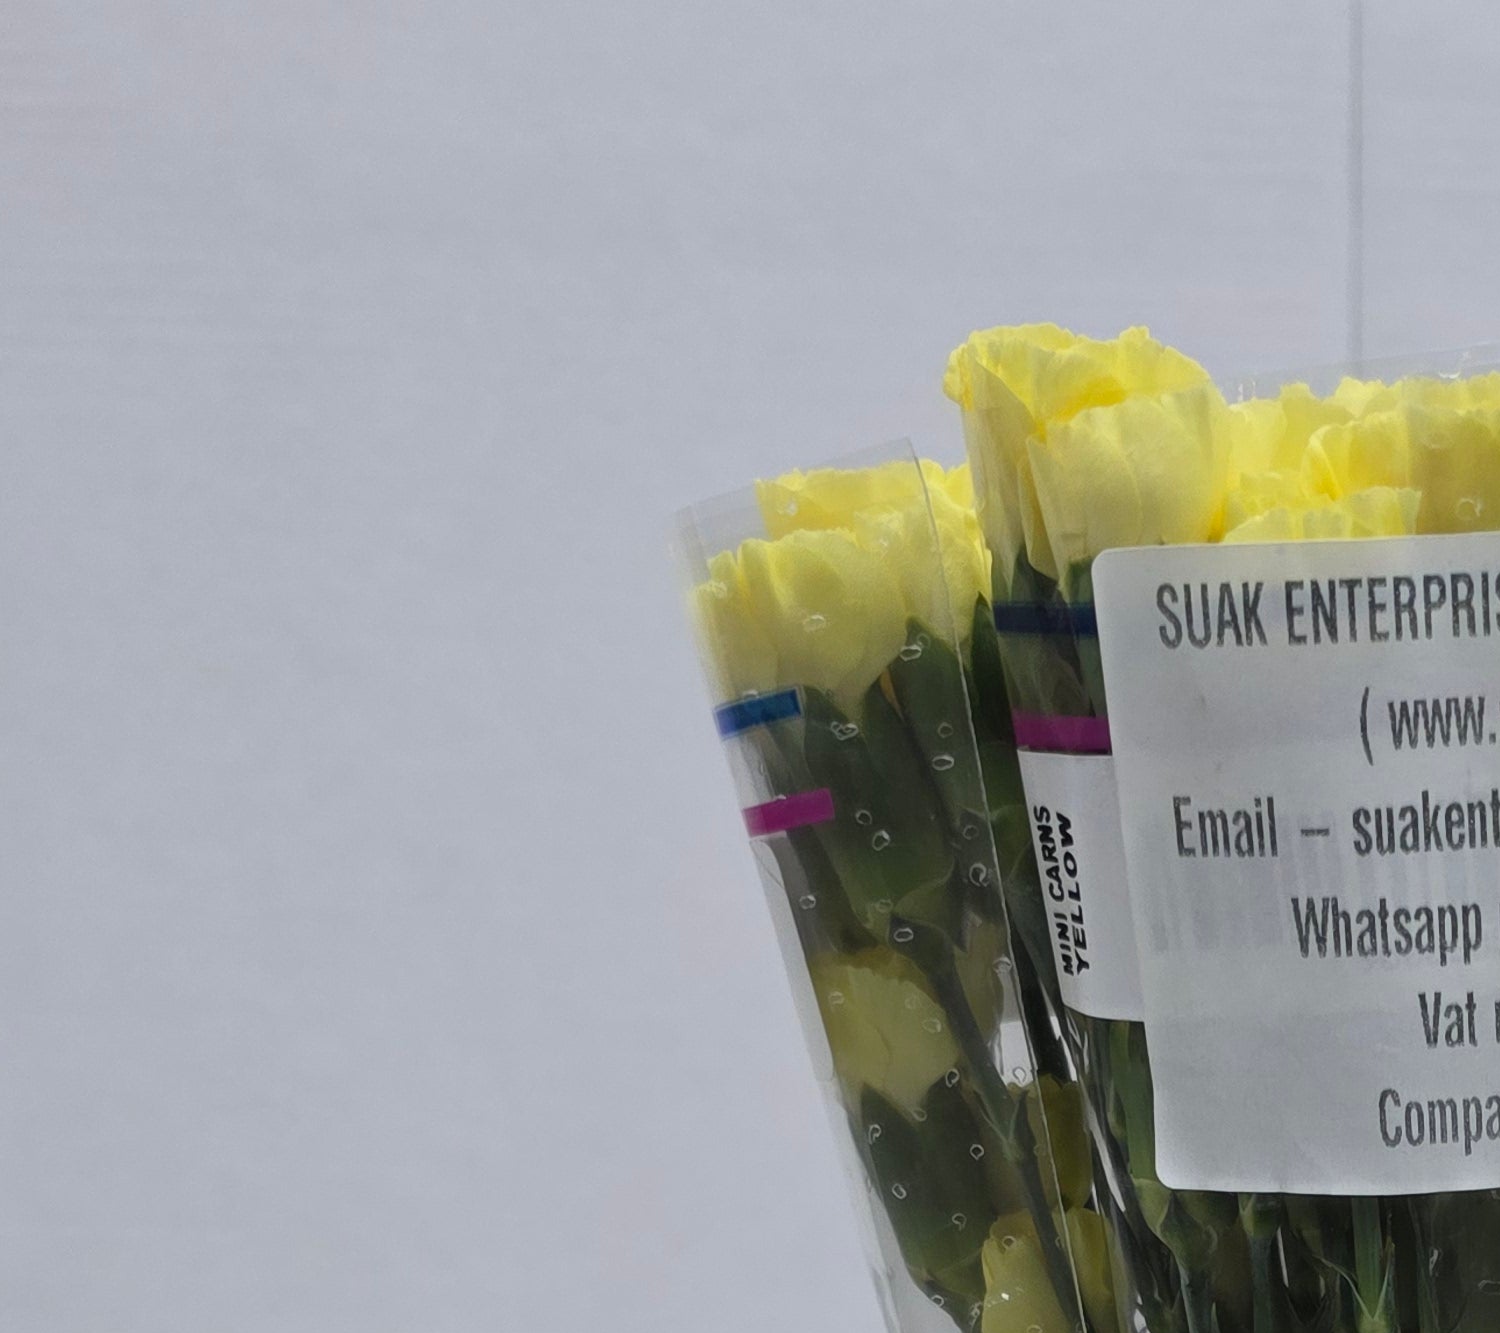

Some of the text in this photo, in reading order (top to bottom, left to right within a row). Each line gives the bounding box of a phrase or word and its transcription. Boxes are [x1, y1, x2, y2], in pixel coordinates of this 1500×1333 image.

[1157, 582, 1267, 649] SUAK
[1172, 795, 1277, 858] Email
[1033, 805, 1075, 977] MINI CARNS
[1056, 812, 1090, 975] YELLOW
[1290, 896, 1482, 967] Whatsapp
[1418, 991, 1477, 1048] Vat
